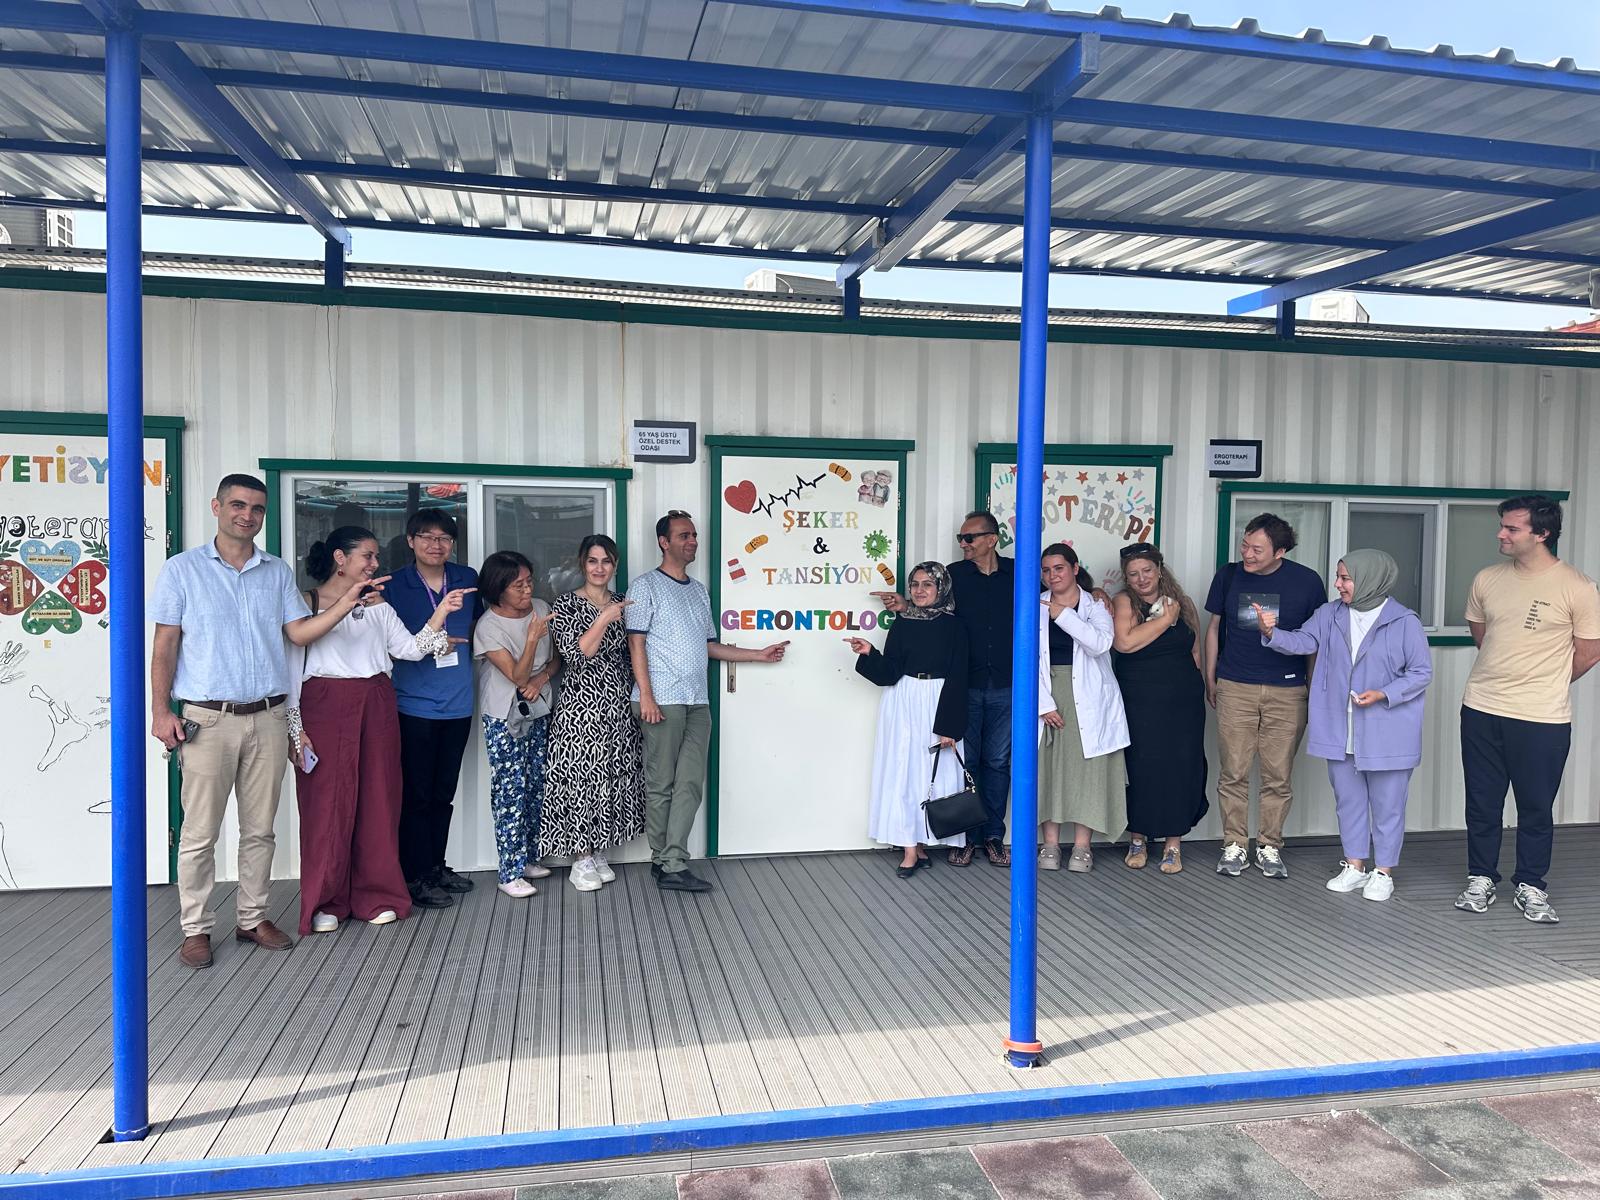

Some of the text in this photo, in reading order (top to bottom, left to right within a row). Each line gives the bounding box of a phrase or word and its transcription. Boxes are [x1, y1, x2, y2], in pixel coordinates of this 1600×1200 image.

[647, 431, 660, 439] YAŞ
[660, 431, 677, 439] ÜSTÜ
[656, 438, 681, 446] DESTEK
[782, 509, 859, 533] ŞEKER
[998, 494, 1155, 549] EOTERAPİ
[813, 537, 830, 555] &
[762, 562, 873, 585] TANSİYON
[721, 609, 896, 631] GERONTOLOG
